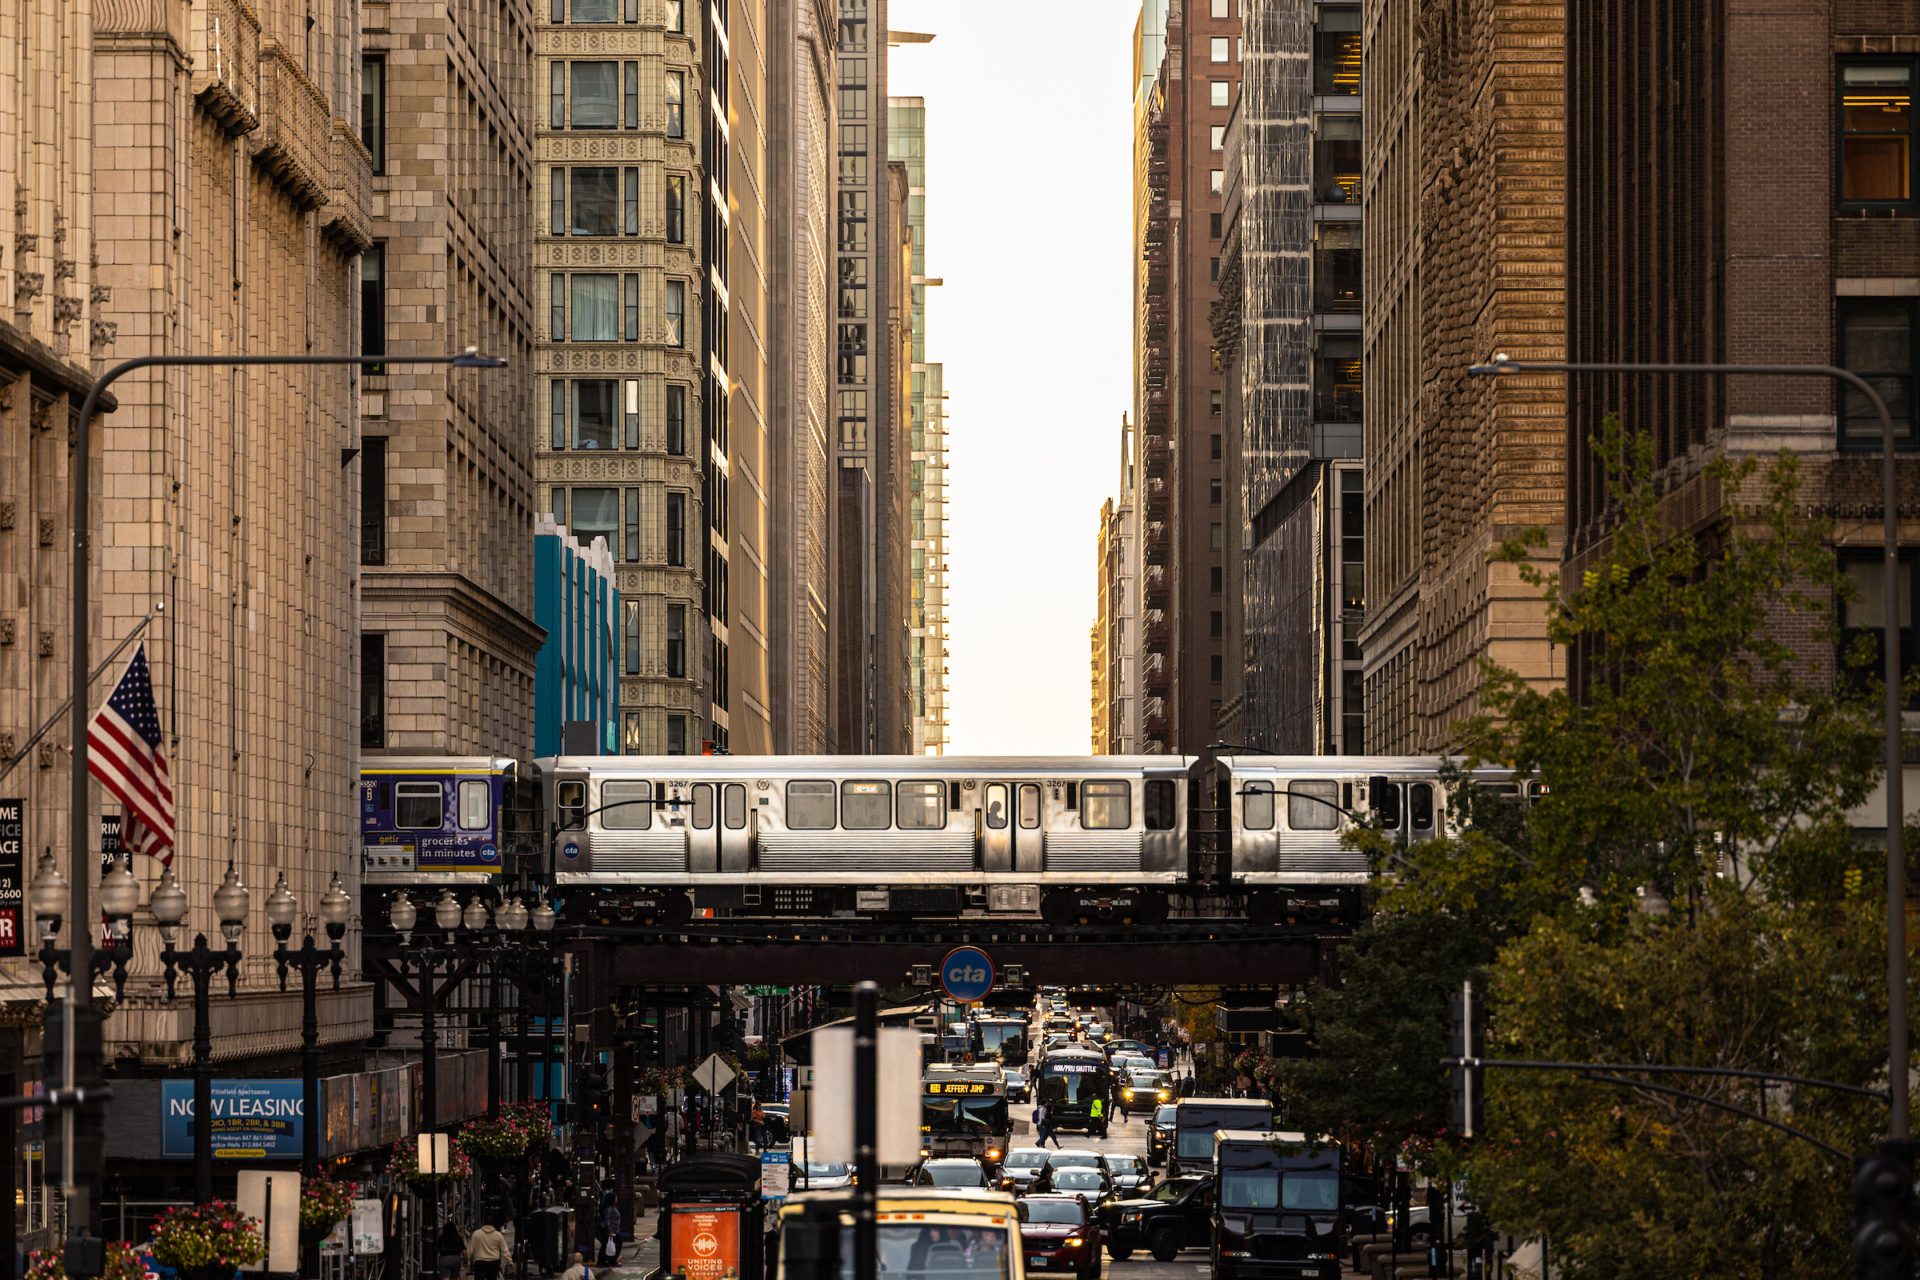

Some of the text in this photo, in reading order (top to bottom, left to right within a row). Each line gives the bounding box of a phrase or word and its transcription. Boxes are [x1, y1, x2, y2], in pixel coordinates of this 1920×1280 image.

[422, 837, 468, 848] groceries
[102, 853, 129, 864] PAE
[422, 849, 476, 858] in minutes
[949, 964, 985, 982] cta
[238, 1088, 270, 1096] Apartments
[944, 1084, 968, 1093] JEFFERY
[970, 1084, 984, 1093] JUMP
